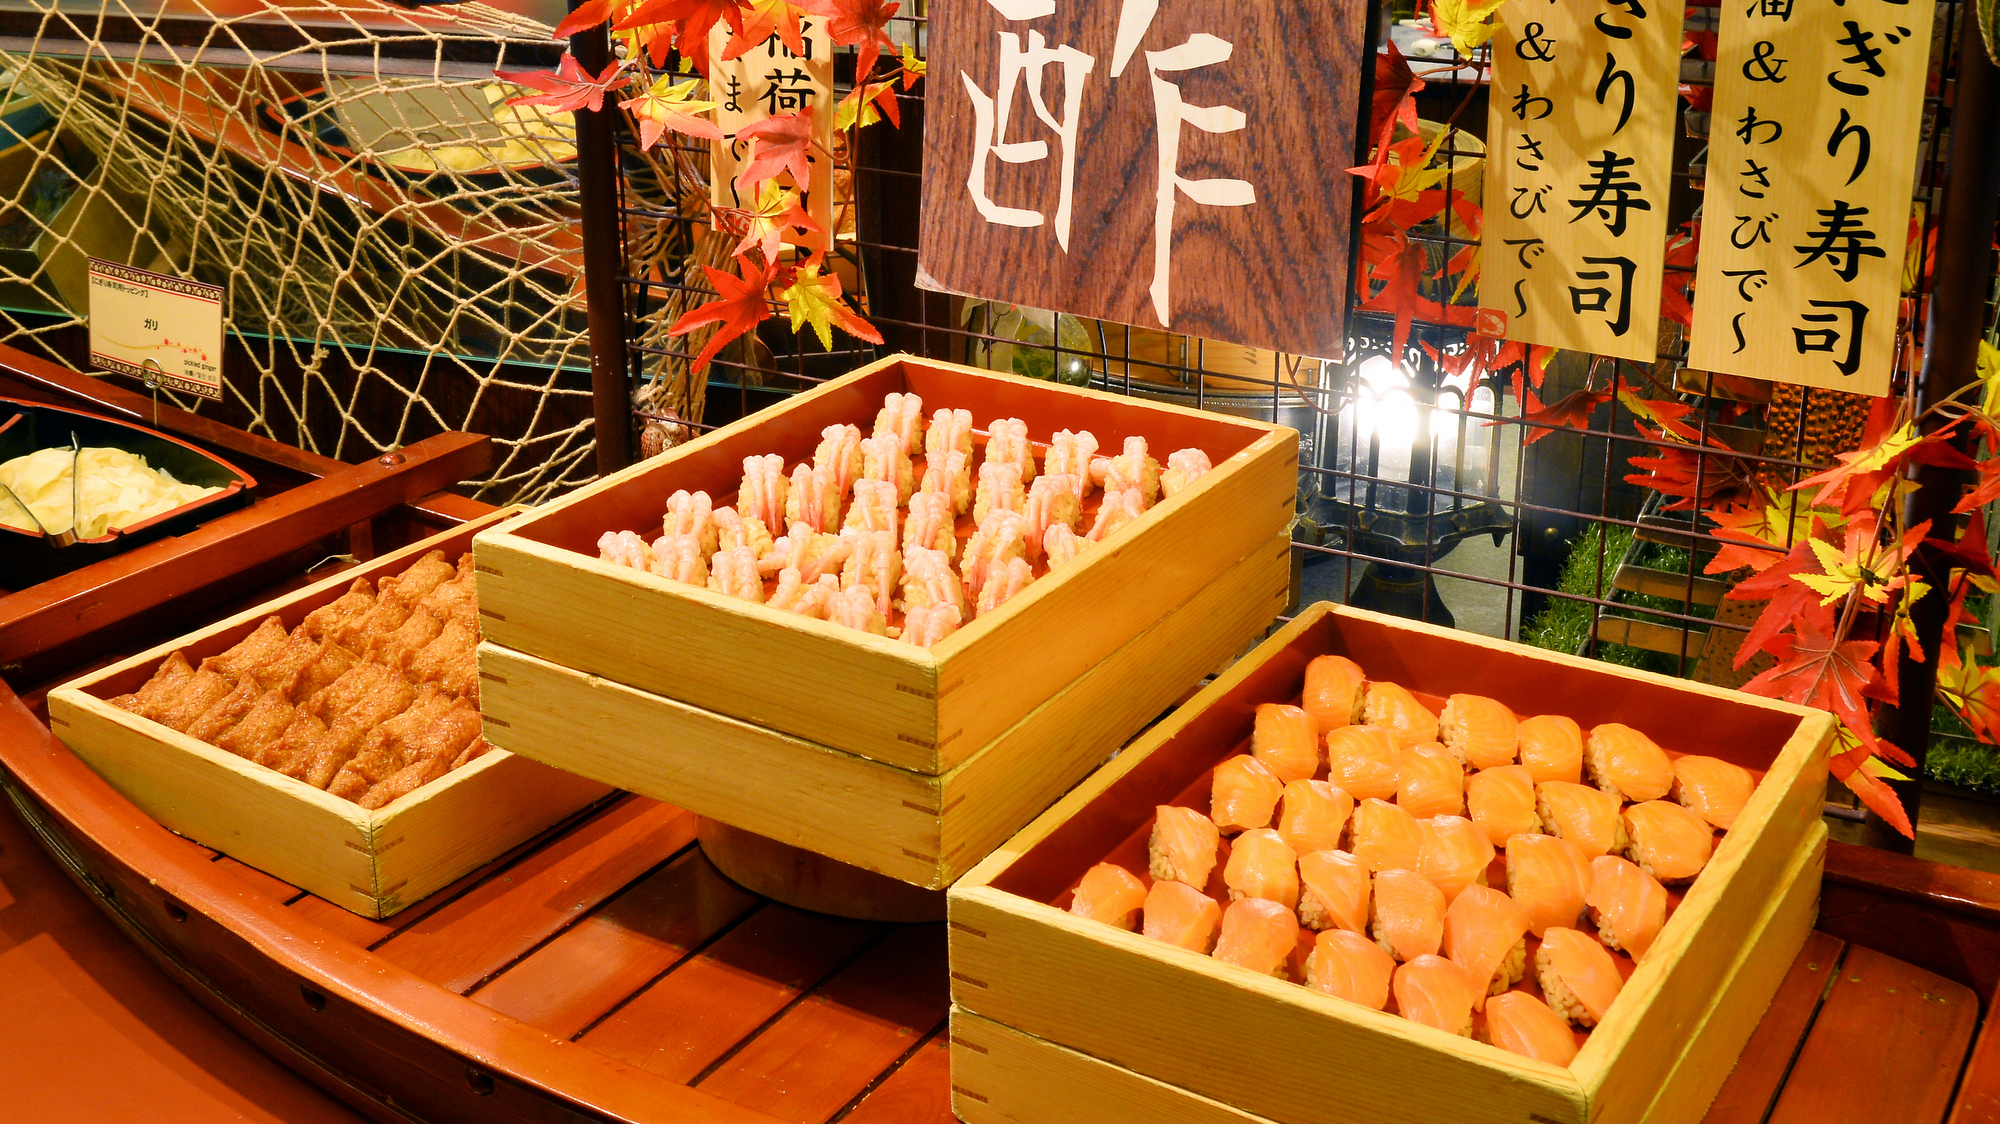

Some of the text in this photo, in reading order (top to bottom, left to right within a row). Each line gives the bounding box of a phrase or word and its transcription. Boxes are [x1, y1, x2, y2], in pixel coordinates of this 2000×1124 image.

[1791, 0, 1912, 377] ぎり寿司
[144, 318, 158, 331] ガリ
